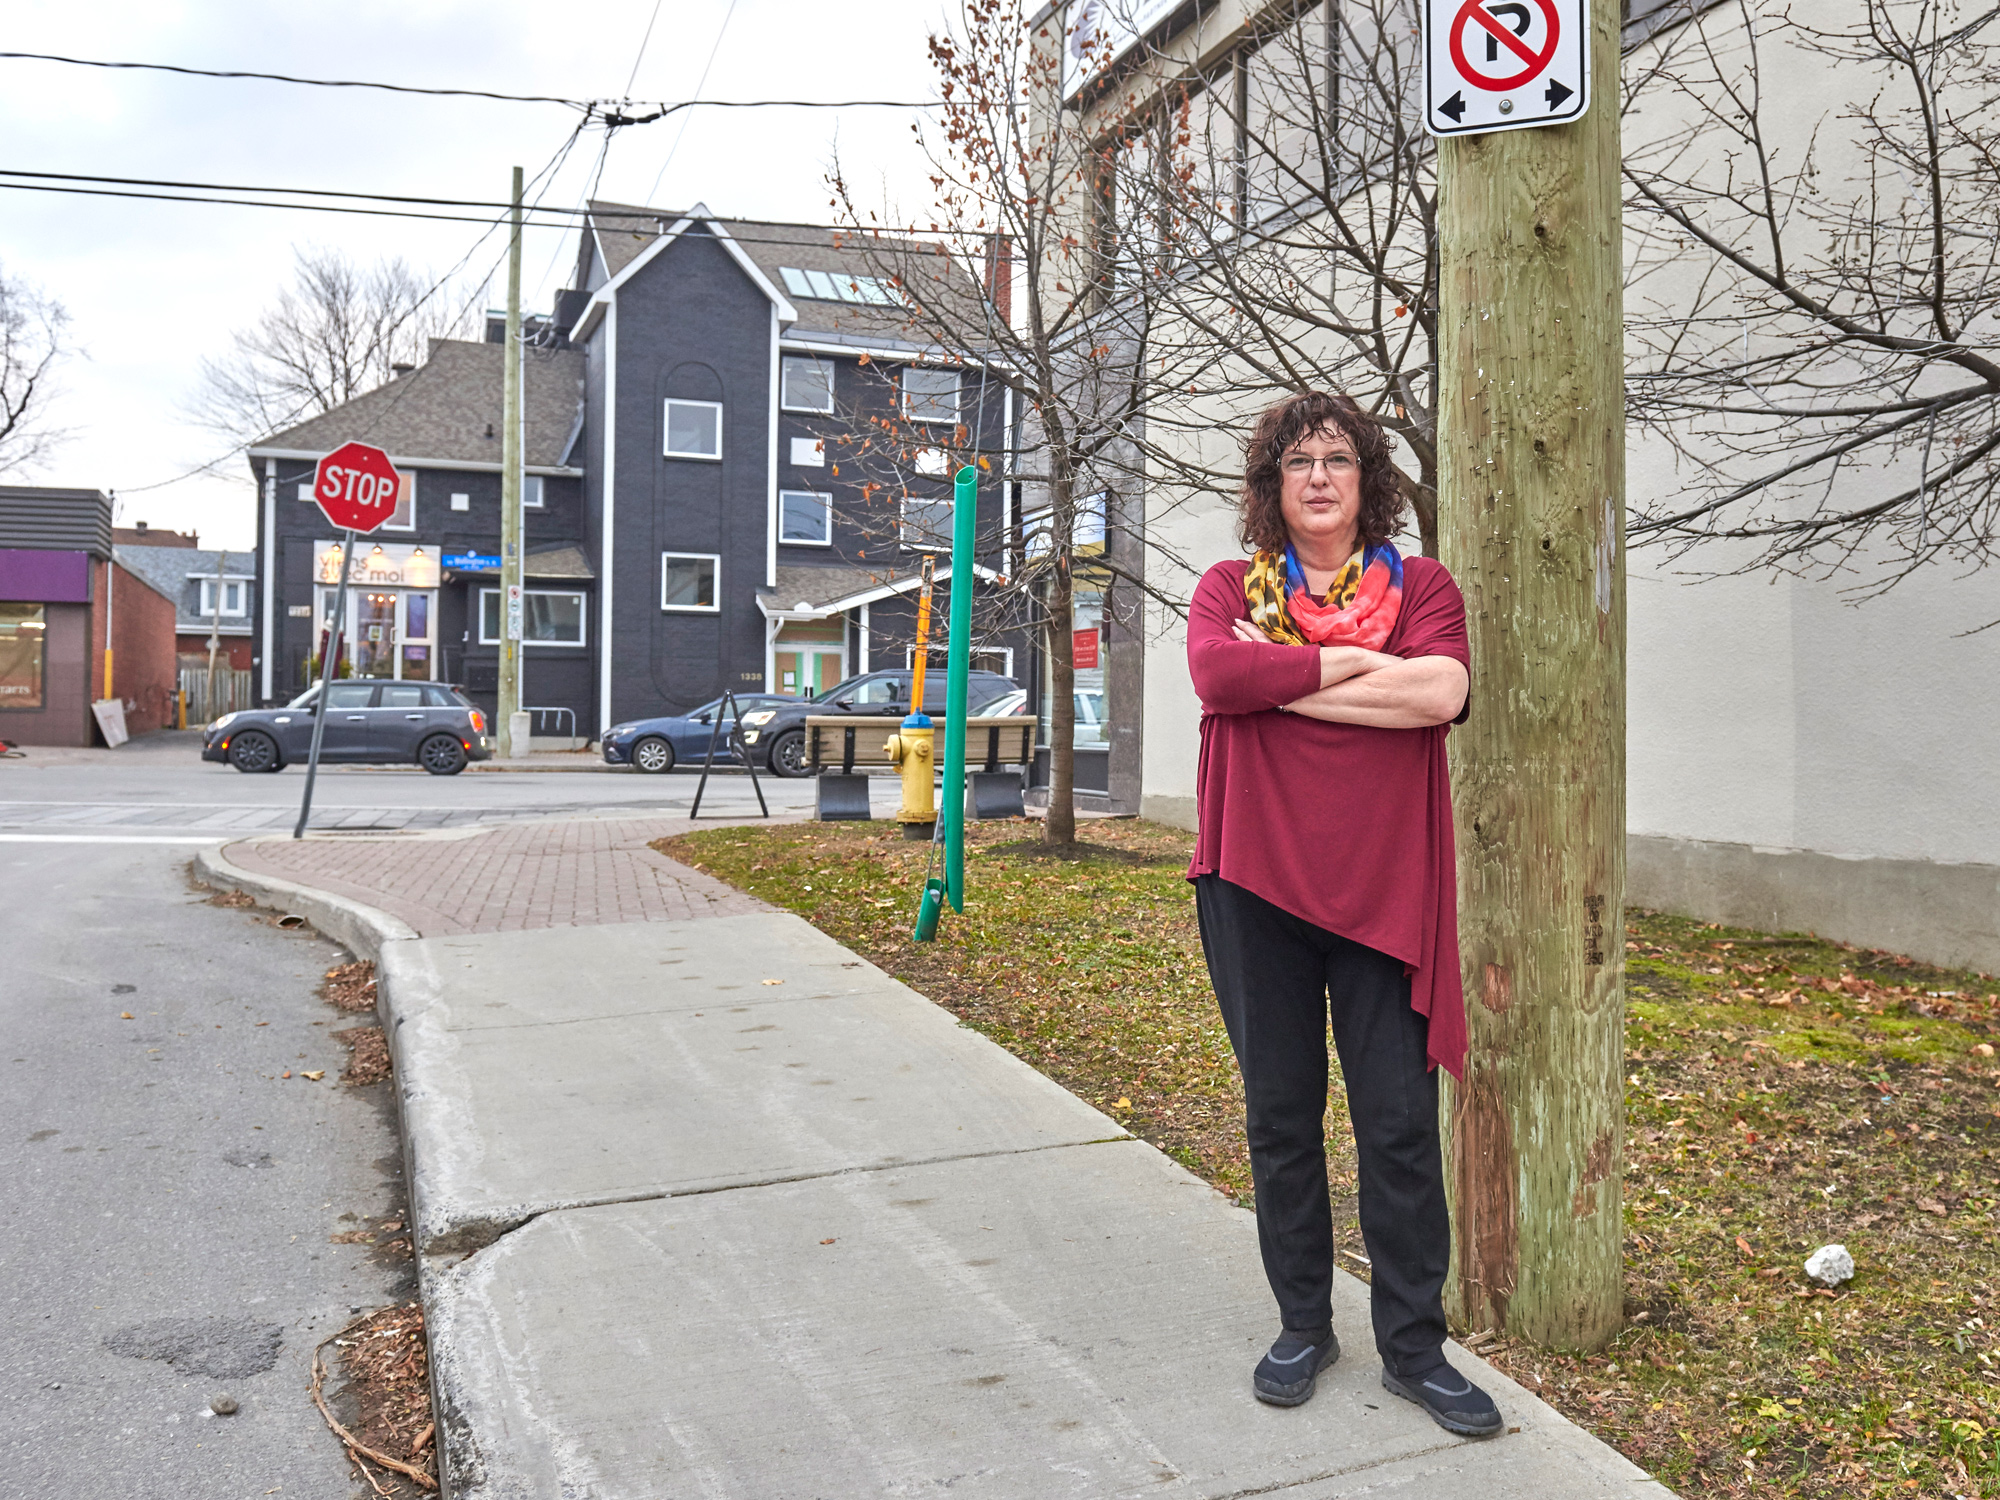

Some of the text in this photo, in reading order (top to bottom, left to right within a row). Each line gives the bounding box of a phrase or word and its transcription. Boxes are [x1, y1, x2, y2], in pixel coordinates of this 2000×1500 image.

[1486, 2, 1531, 62] P
[322, 464, 394, 508] STOP
[369, 567, 404, 583] moi
